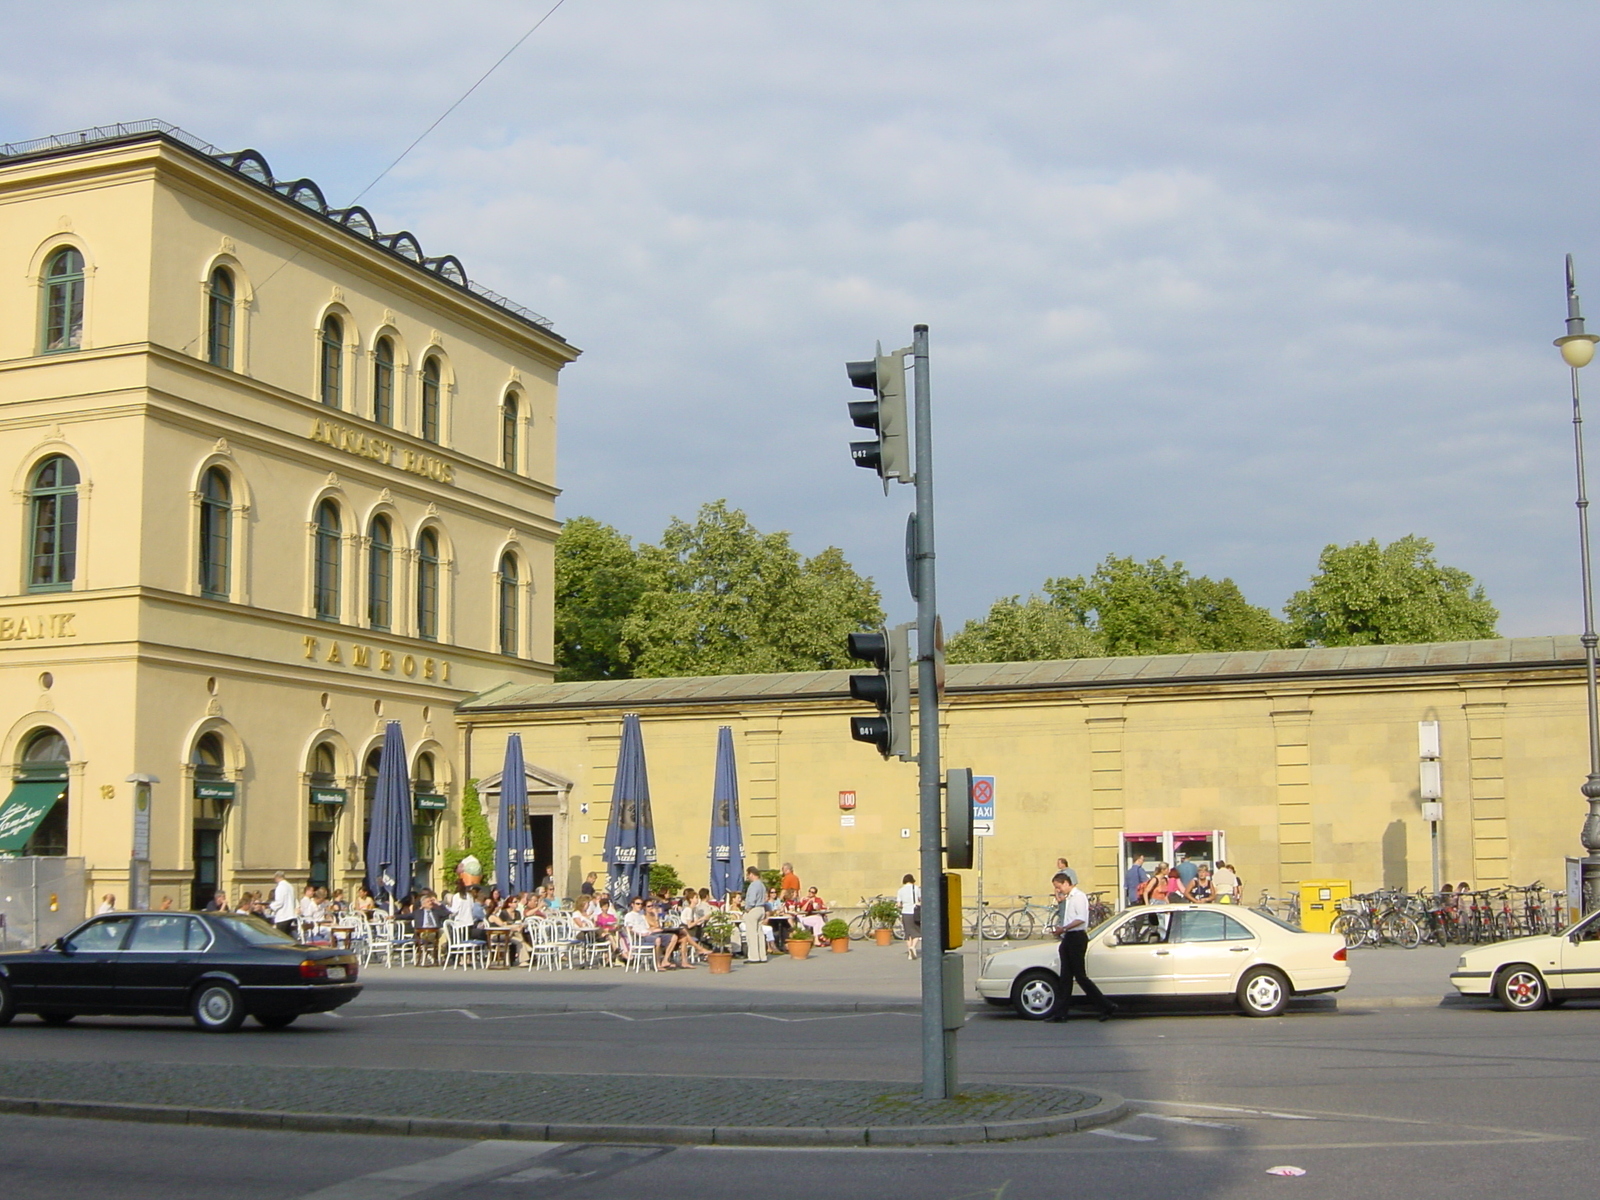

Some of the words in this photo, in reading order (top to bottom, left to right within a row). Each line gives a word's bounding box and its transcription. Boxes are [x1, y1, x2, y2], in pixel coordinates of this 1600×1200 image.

[310, 417, 394, 465] ANNAST
[403, 448, 453, 483] HAUS
[852, 450, 867, 458] 042
[0, 612, 76, 641] BANK
[303, 635, 450, 681] TAMBOSI
[859, 727, 873, 735] 041
[973, 806, 993, 817] TAXI
